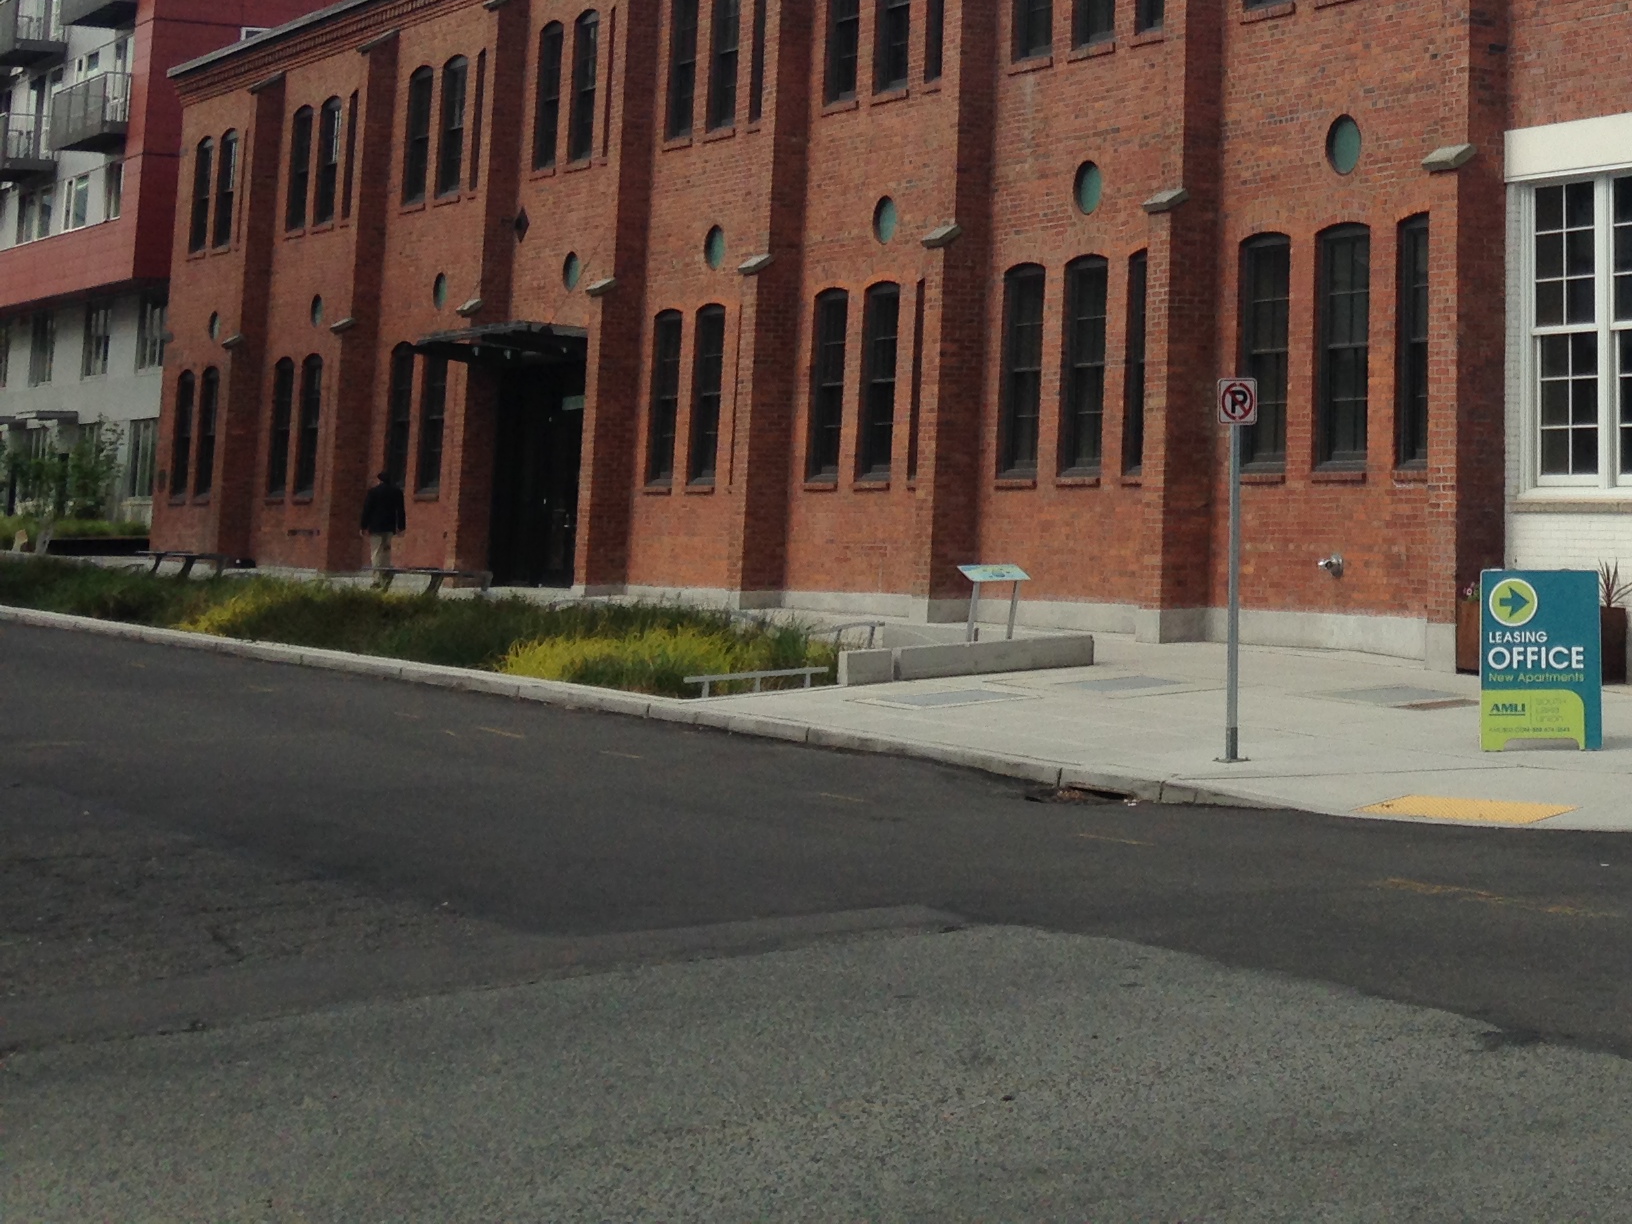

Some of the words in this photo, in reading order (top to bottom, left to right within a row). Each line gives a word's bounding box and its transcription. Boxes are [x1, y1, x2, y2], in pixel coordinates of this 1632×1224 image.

[1489, 631, 1548, 643] LEASING
[1488, 646, 1584, 670] OFFICE
[1489, 673, 1514, 682] New
[1518, 672, 1584, 683] Apartments
[1489, 703, 1526, 713] AMLI
